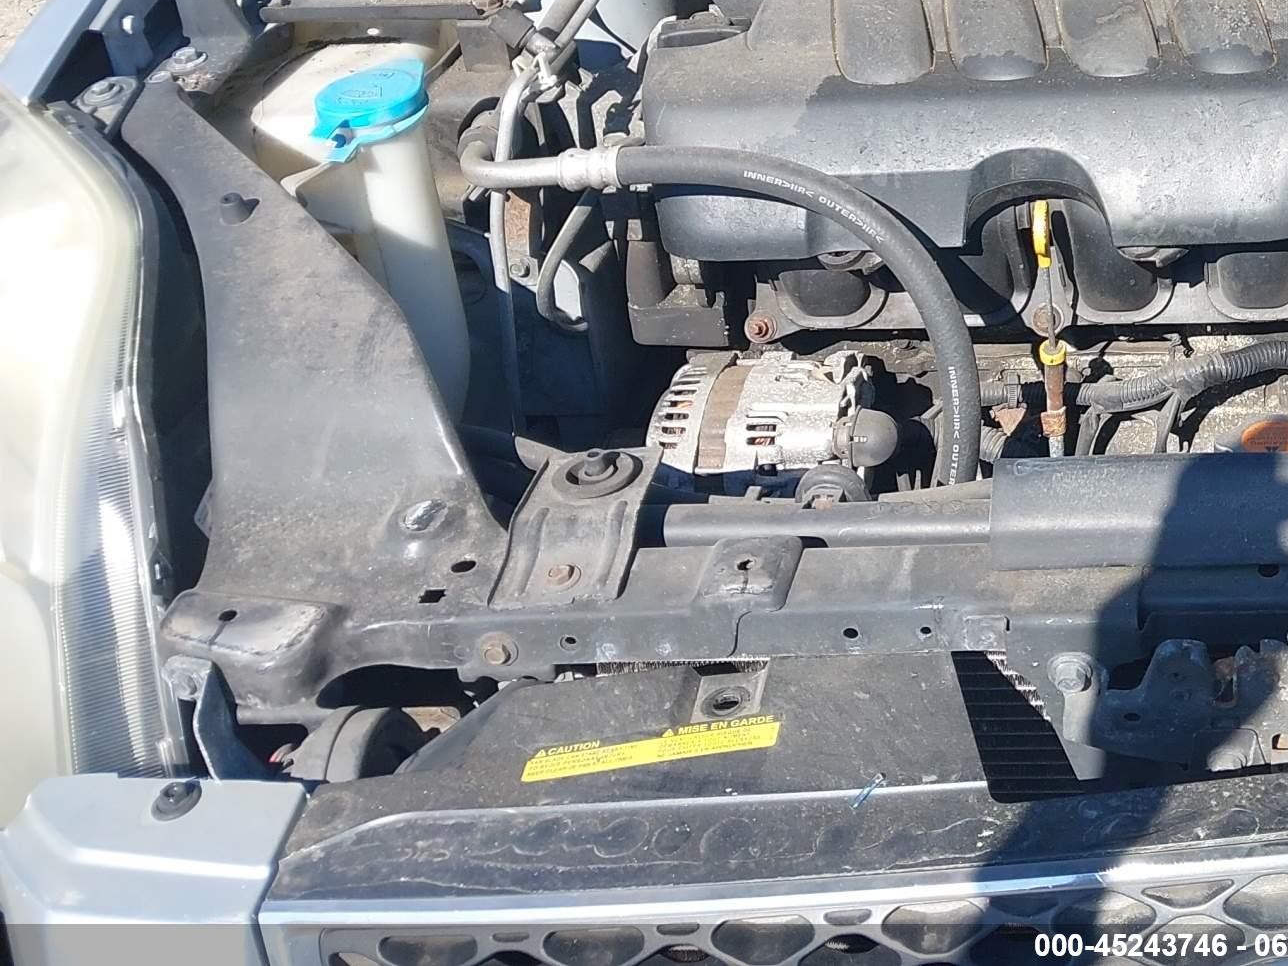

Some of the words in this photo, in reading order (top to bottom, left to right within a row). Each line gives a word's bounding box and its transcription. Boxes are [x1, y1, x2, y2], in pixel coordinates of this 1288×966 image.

[677, 723, 708, 735] MISE
[710, 720, 728, 731] EN
[730, 715, 775, 728] GARDE
[547, 739, 600, 756] CAUTION
